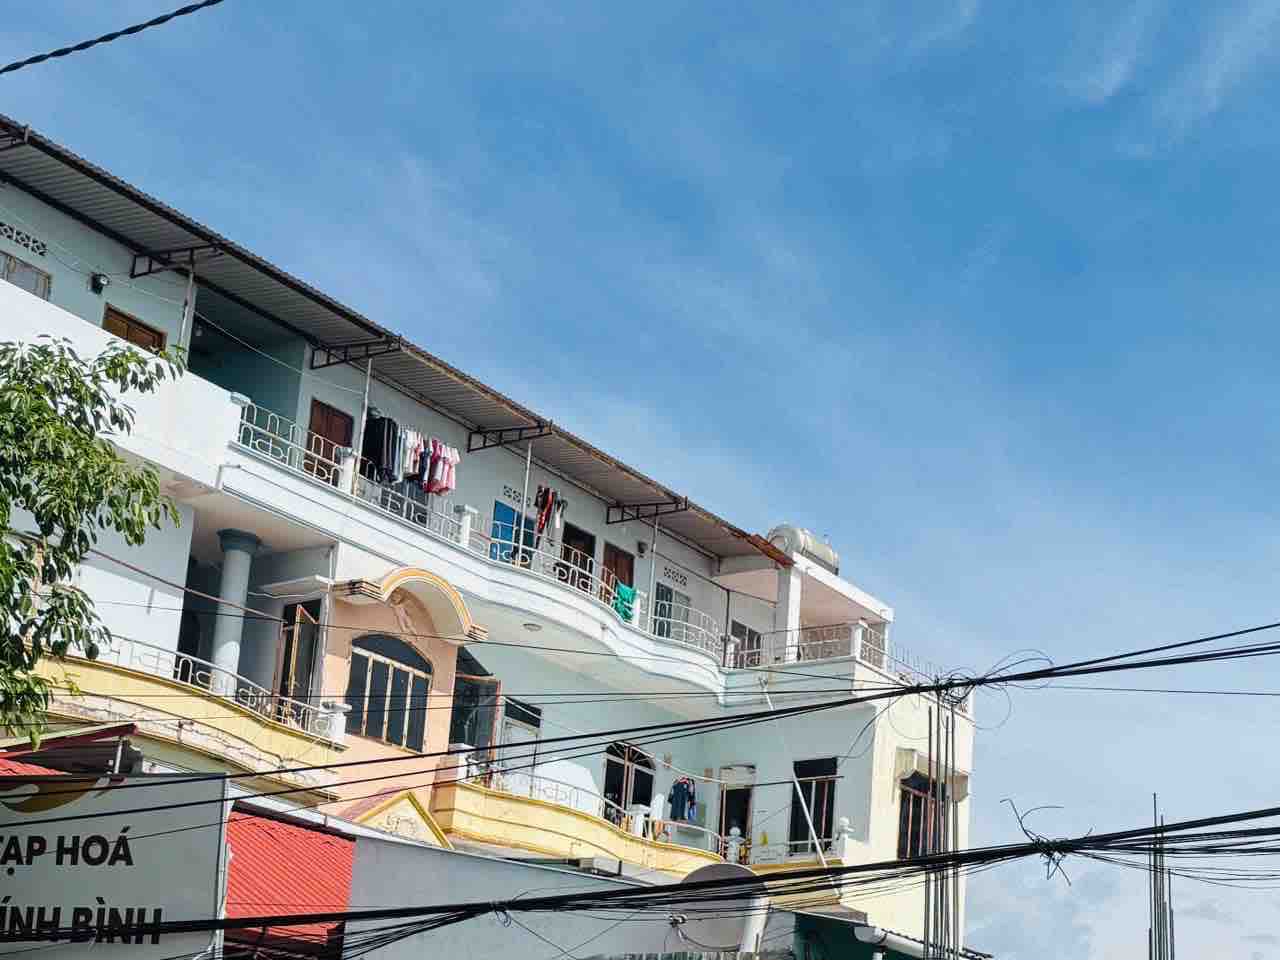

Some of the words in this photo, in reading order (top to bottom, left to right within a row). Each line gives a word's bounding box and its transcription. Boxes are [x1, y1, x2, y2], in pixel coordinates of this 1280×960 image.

[0, 834, 47, 875] ẠP
[56, 826, 134, 866] HOÁ
[71, 897, 162, 944] BÌNH
